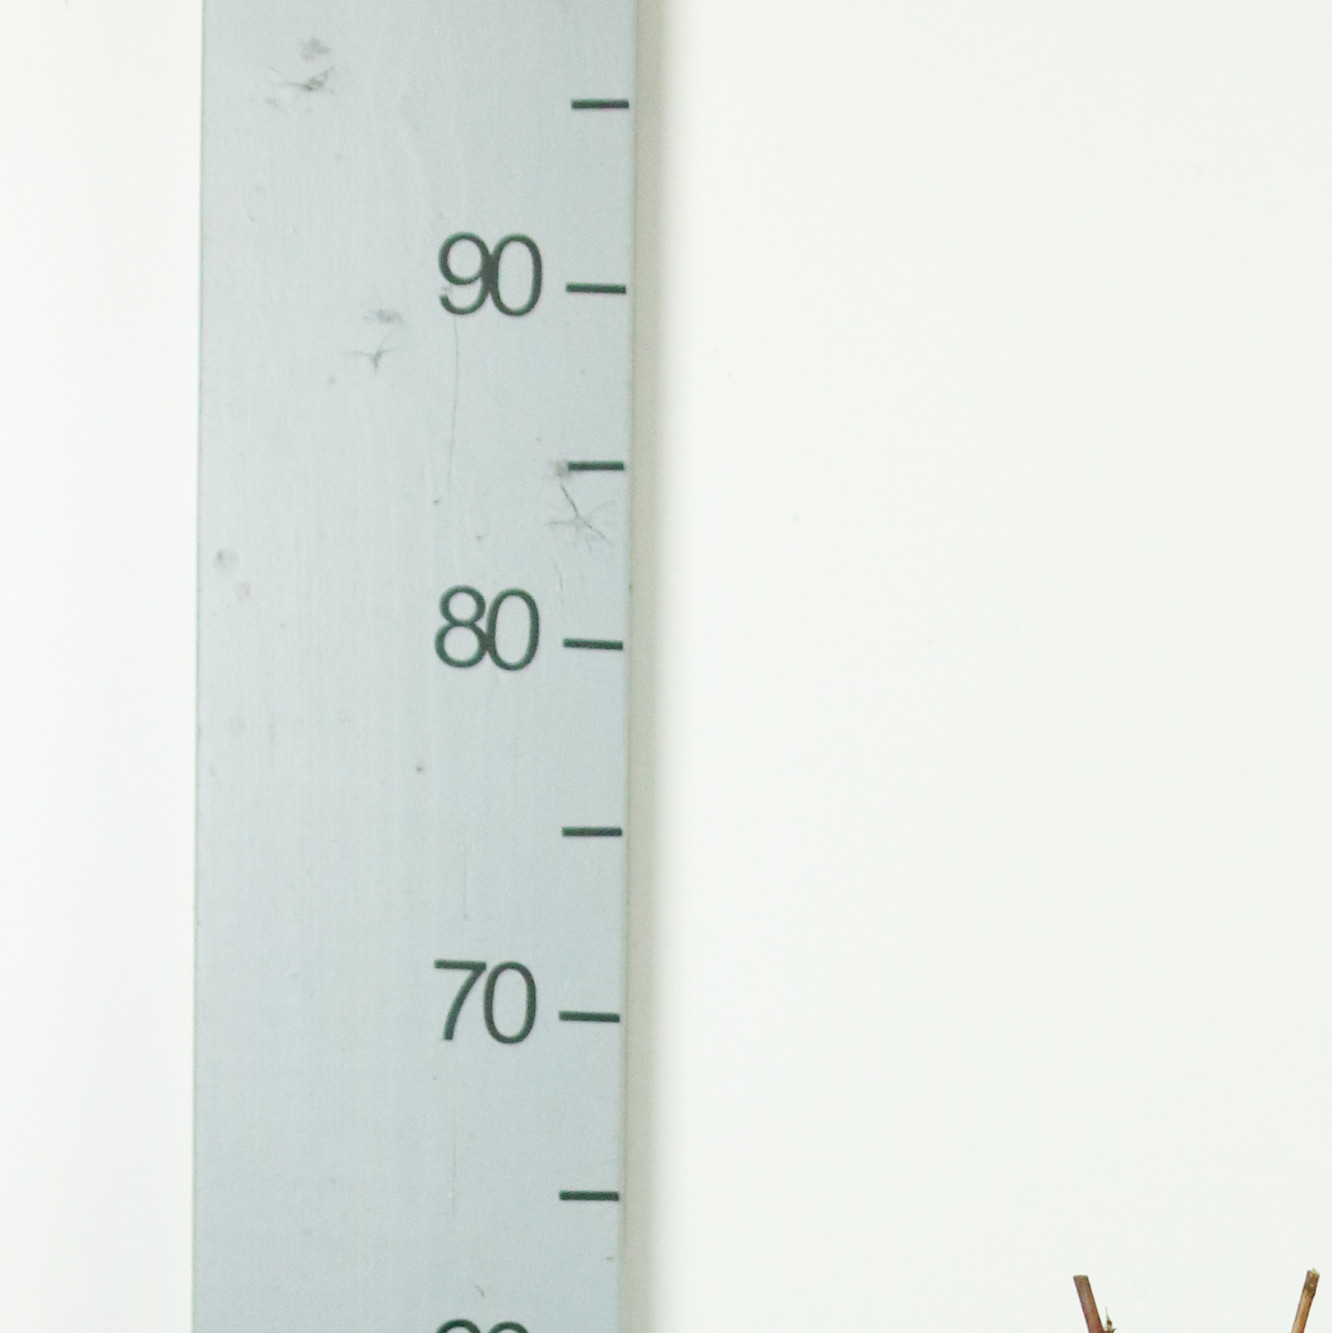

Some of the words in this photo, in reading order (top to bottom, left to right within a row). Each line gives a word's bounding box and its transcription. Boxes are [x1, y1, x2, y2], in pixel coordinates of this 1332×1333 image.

[438, 231, 543, 317] 90
[434, 584, 540, 671] 80
[433, 958, 538, 1045] 70
